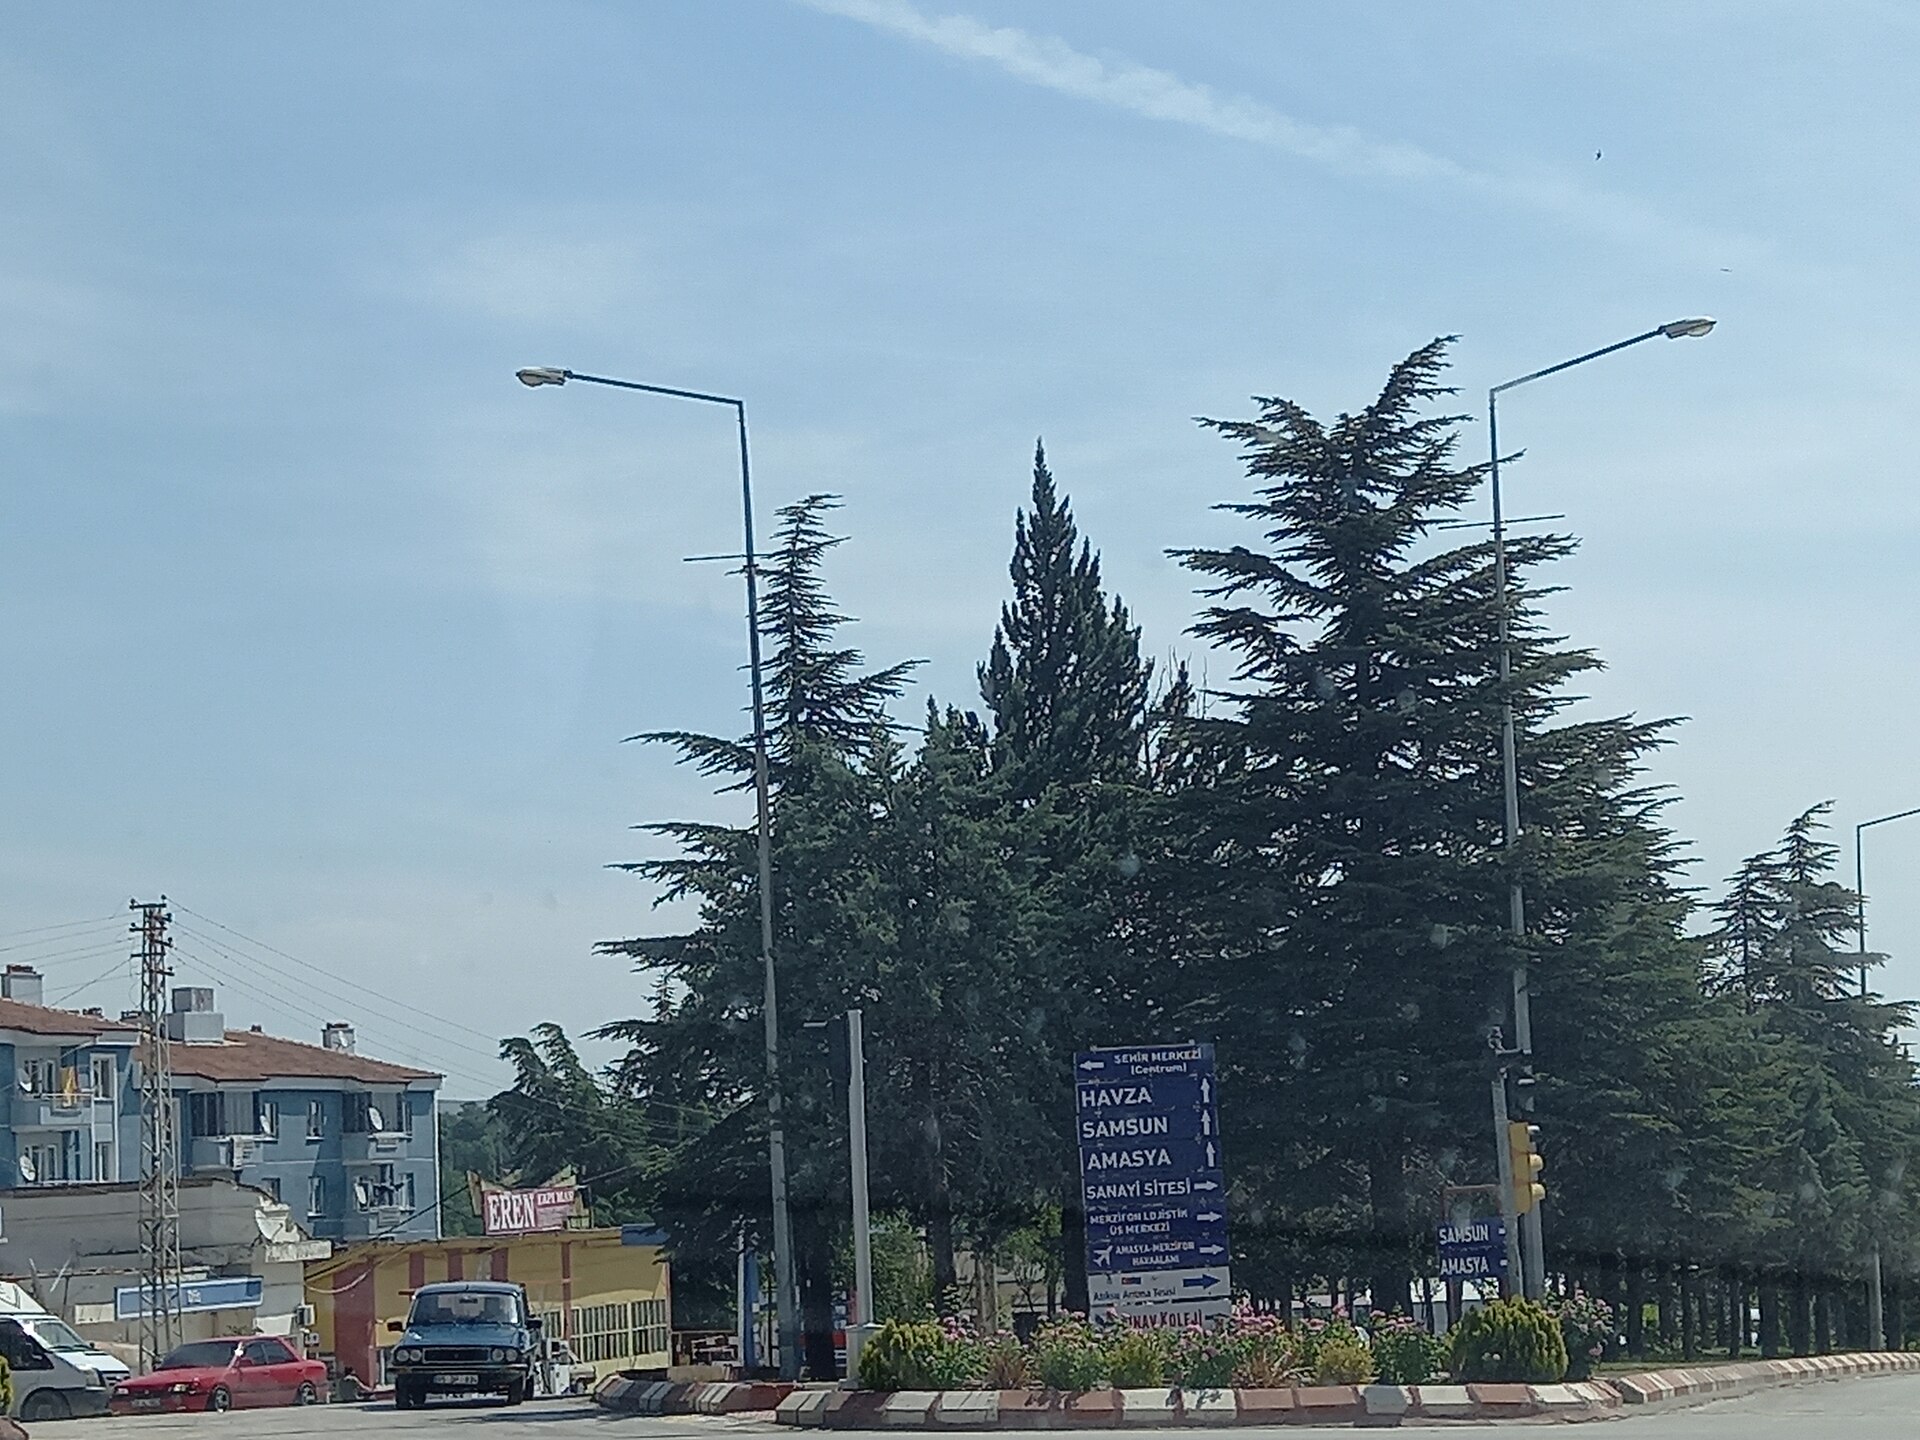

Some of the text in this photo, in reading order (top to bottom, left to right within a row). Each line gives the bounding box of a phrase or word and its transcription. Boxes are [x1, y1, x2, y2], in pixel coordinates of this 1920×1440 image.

[1151, 1048, 1201, 1061] MERKEZİ
[1130, 1062, 1187, 1075] (Centrum)
[1081, 1087, 1152, 1108] HAVZA
[1082, 1116, 1168, 1139] SAMSUN
[1087, 1148, 1172, 1170] AMASYA
[1086, 1177, 1191, 1200] SANAYİ SİTESİ
[487, 1192, 536, 1230] EREN
[1439, 1224, 1489, 1245] SAMSUN
[1440, 1256, 1489, 1275] AMASYA
